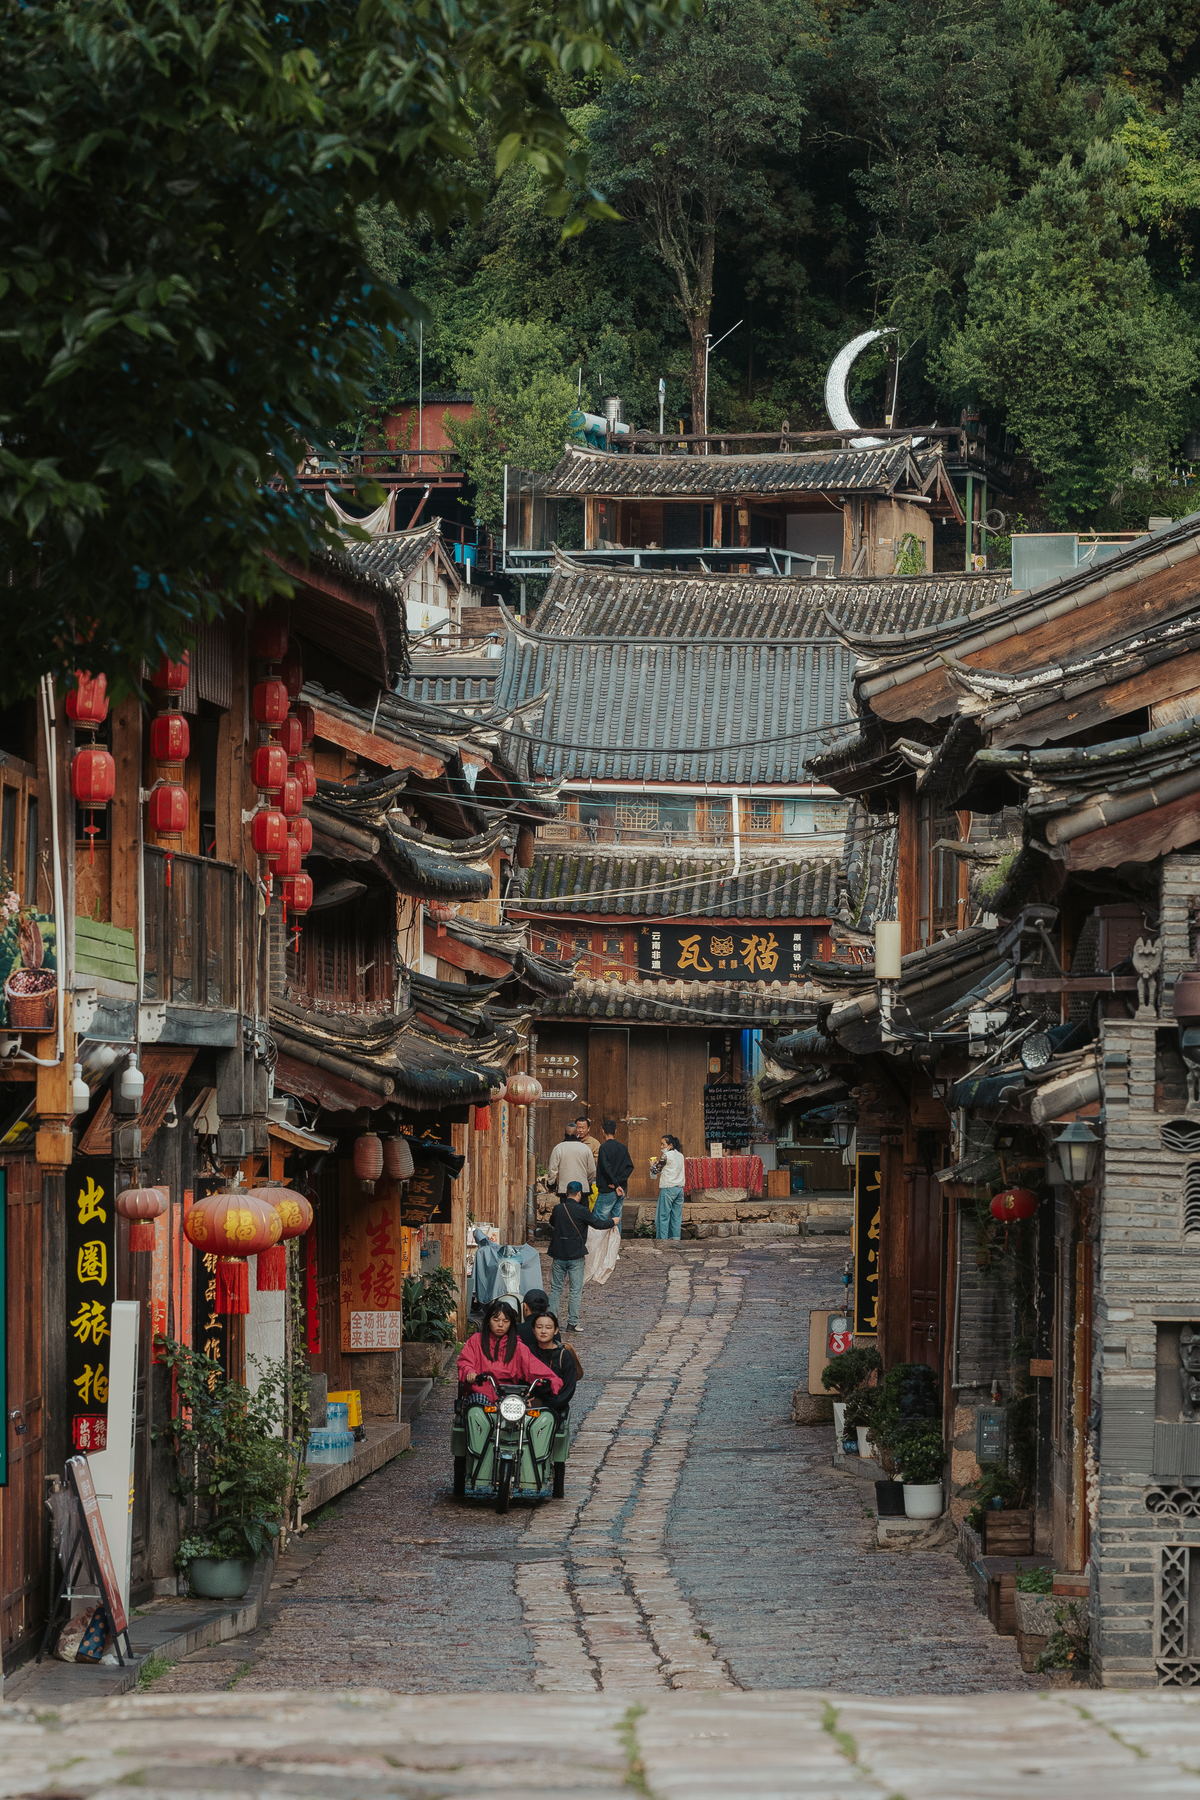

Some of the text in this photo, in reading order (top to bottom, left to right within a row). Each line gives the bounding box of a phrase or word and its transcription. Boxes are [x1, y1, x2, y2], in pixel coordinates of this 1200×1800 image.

[793, 933, 802, 971] 原创设计
[223, 1208, 257, 1241] 福
[276, 1200, 303, 1228] 福
[70, 1176, 111, 1404] 出圈旅拍
[351, 1312, 400, 1330] 全场批发
[351, 1330, 400, 1348] 来料定做
